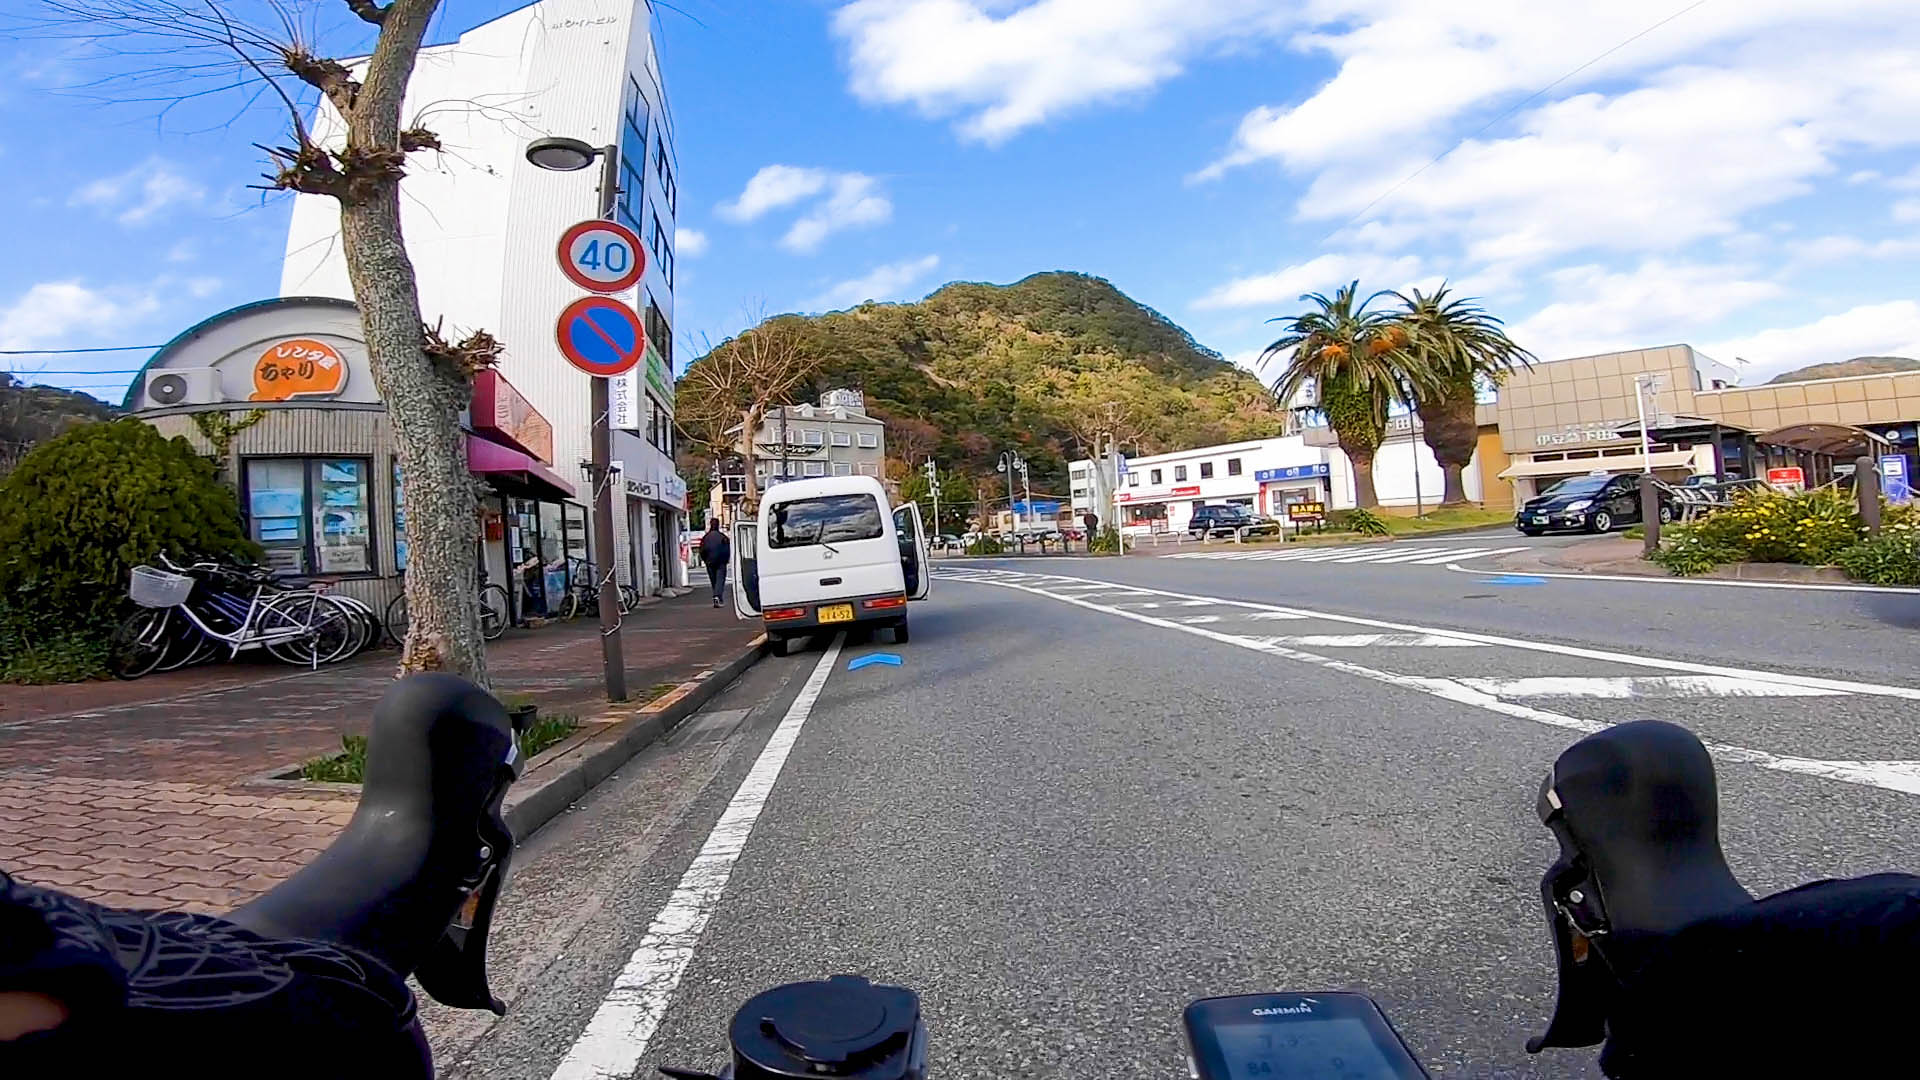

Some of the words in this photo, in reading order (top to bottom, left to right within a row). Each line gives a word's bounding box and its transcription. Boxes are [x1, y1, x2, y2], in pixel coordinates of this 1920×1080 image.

[579, 239, 627, 272] 40
[260, 360, 314, 381] ちゃり
[616, 377, 628, 425] 株式会社
[1252, 1003, 1311, 1016] GARMIN
